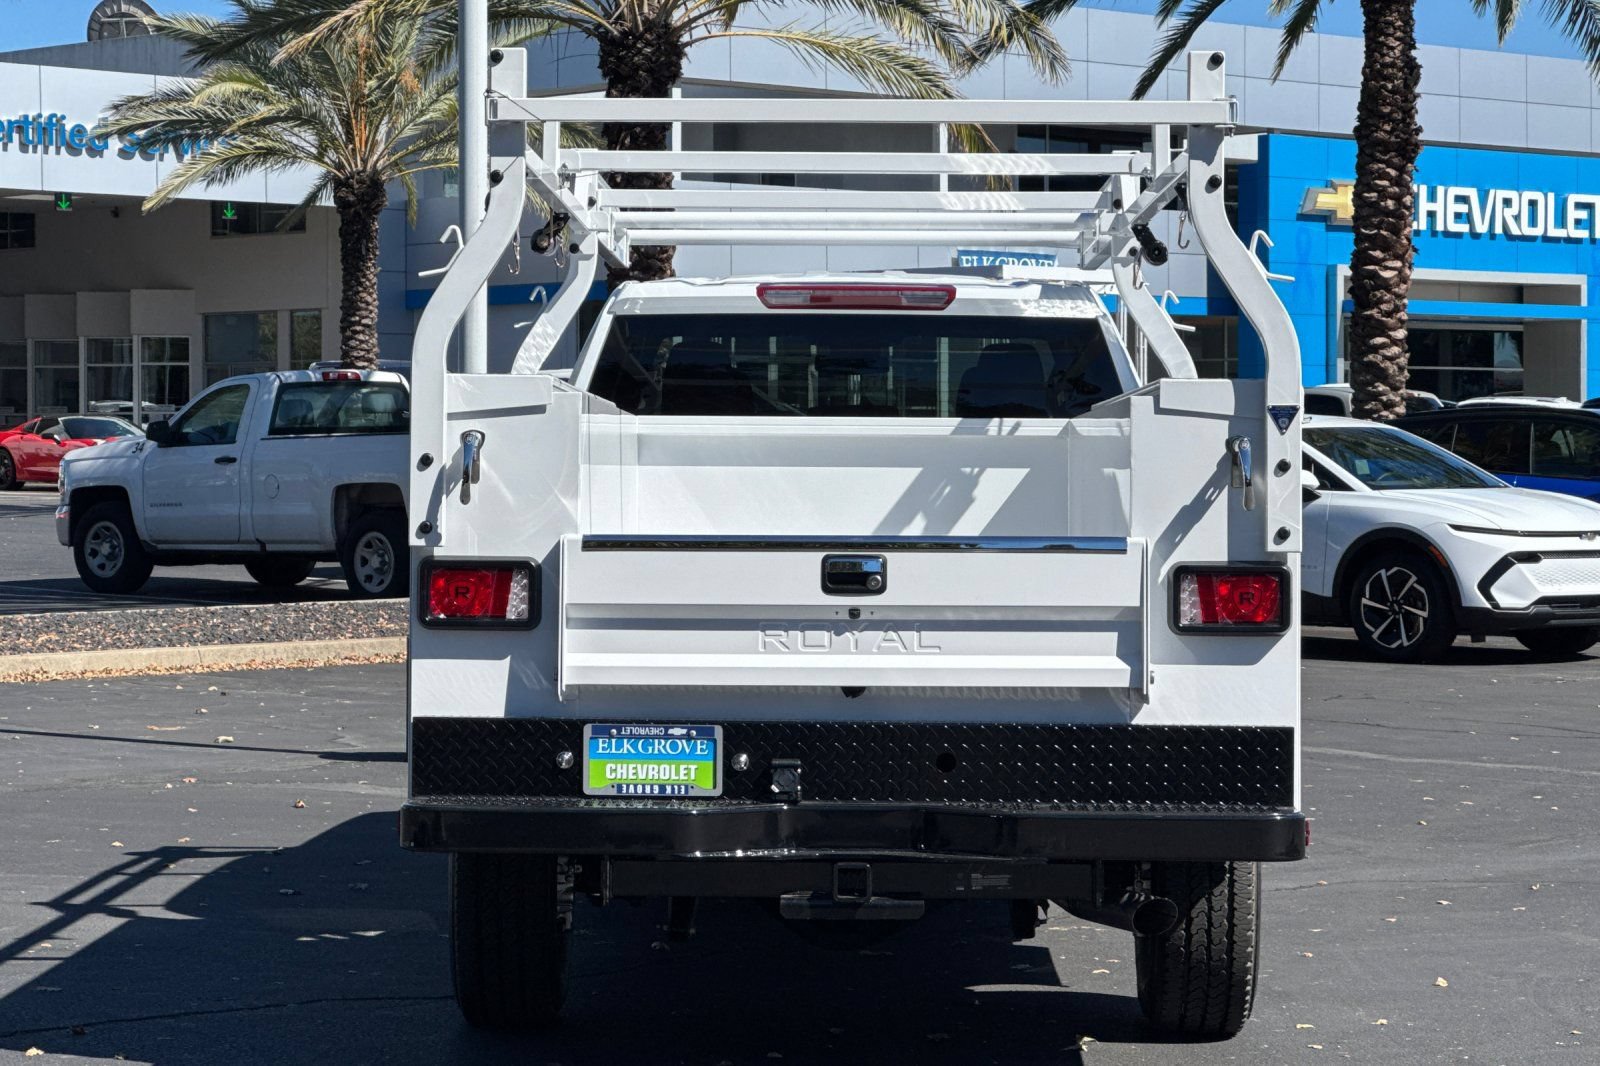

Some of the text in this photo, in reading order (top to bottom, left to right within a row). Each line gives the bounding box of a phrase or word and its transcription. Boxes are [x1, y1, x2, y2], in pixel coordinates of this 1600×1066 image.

[1412, 183, 1600, 239] HEVROLET
[454, 586, 470, 598] R
[1239, 592, 1254, 604] R
[758, 622, 942, 653] ROYAL
[620, 726, 665, 736] CHEVROLET
[605, 763, 699, 780] CHEVROLET
